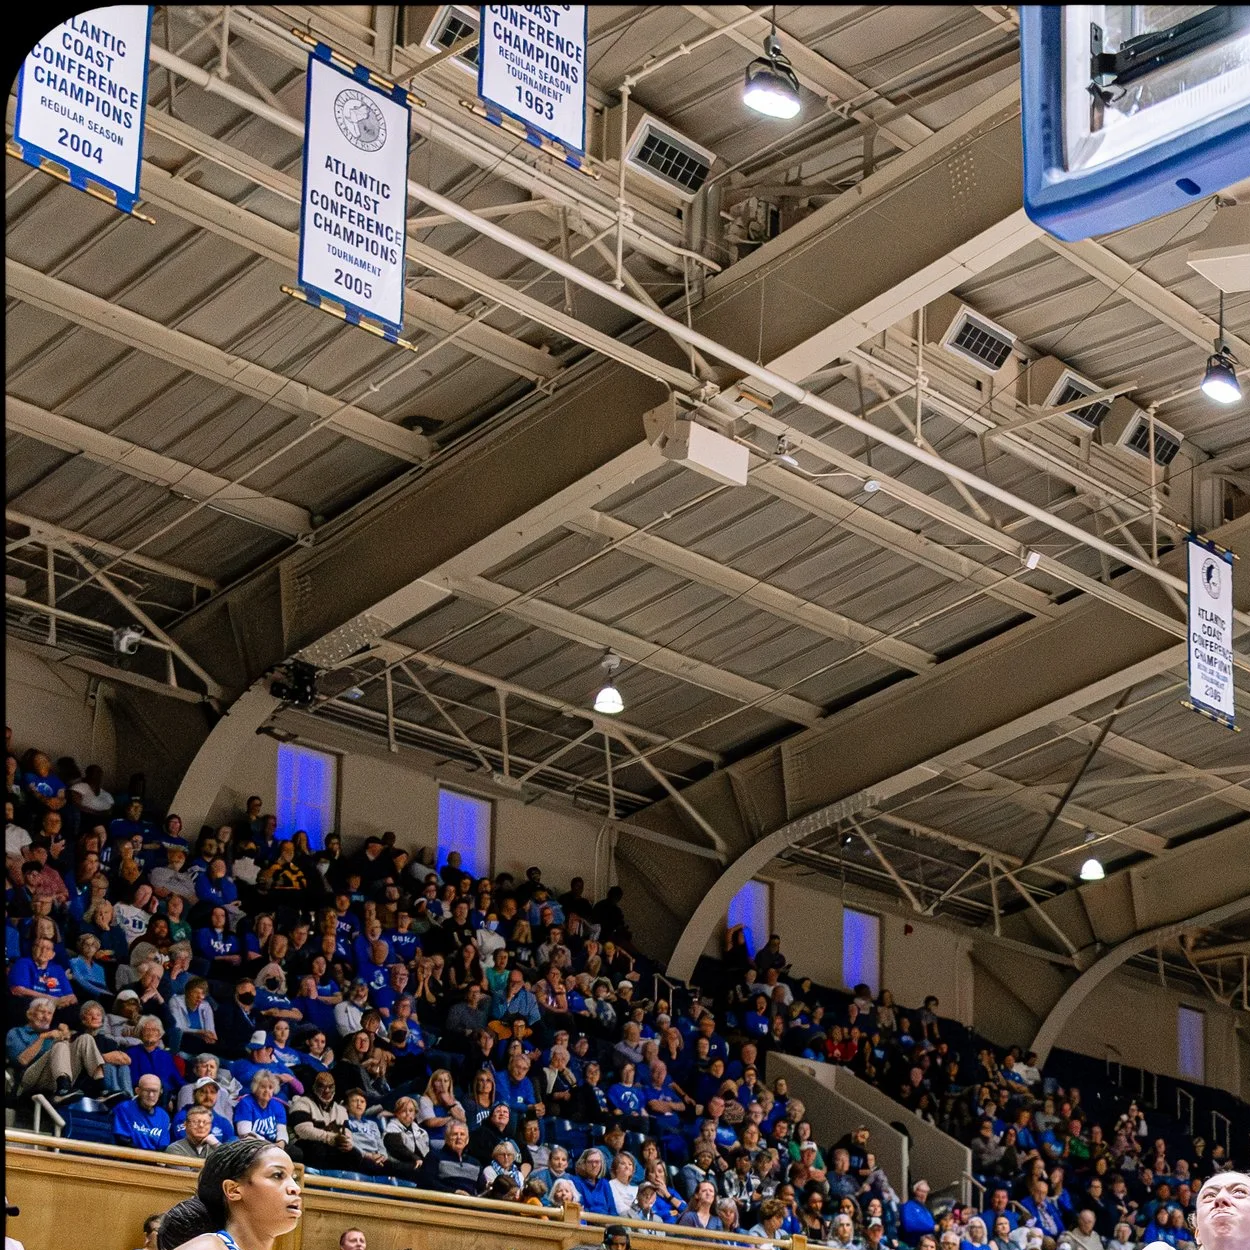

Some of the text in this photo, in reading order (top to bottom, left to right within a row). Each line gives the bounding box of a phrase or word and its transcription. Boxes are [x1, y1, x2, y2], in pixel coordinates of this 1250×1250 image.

[62, 32, 115, 72] COAST
[493, 21, 578, 84] CHAMPIONS
[498, 45, 572, 95] REGULAR SEASON
[31, 41, 138, 110] CONFERENCE
[34, 65, 132, 129] CHAMPIONS
[506, 63, 563, 104] TOURNAMENT
[40, 95, 124, 146] REGULAR SEASON
[515, 85, 554, 121] 1963
[57, 127, 104, 164] 2004
[325, 154, 391, 200] ATLANTIC
[334, 180, 380, 215] COAST
[310, 189, 403, 248] CONFERENCE
[313, 212, 398, 265] CHAMPIONS
[326, 243, 382, 277] TOURNAMENT
[334, 268, 373, 299] 2005
[1197, 607, 1226, 632] ATLANTIC
